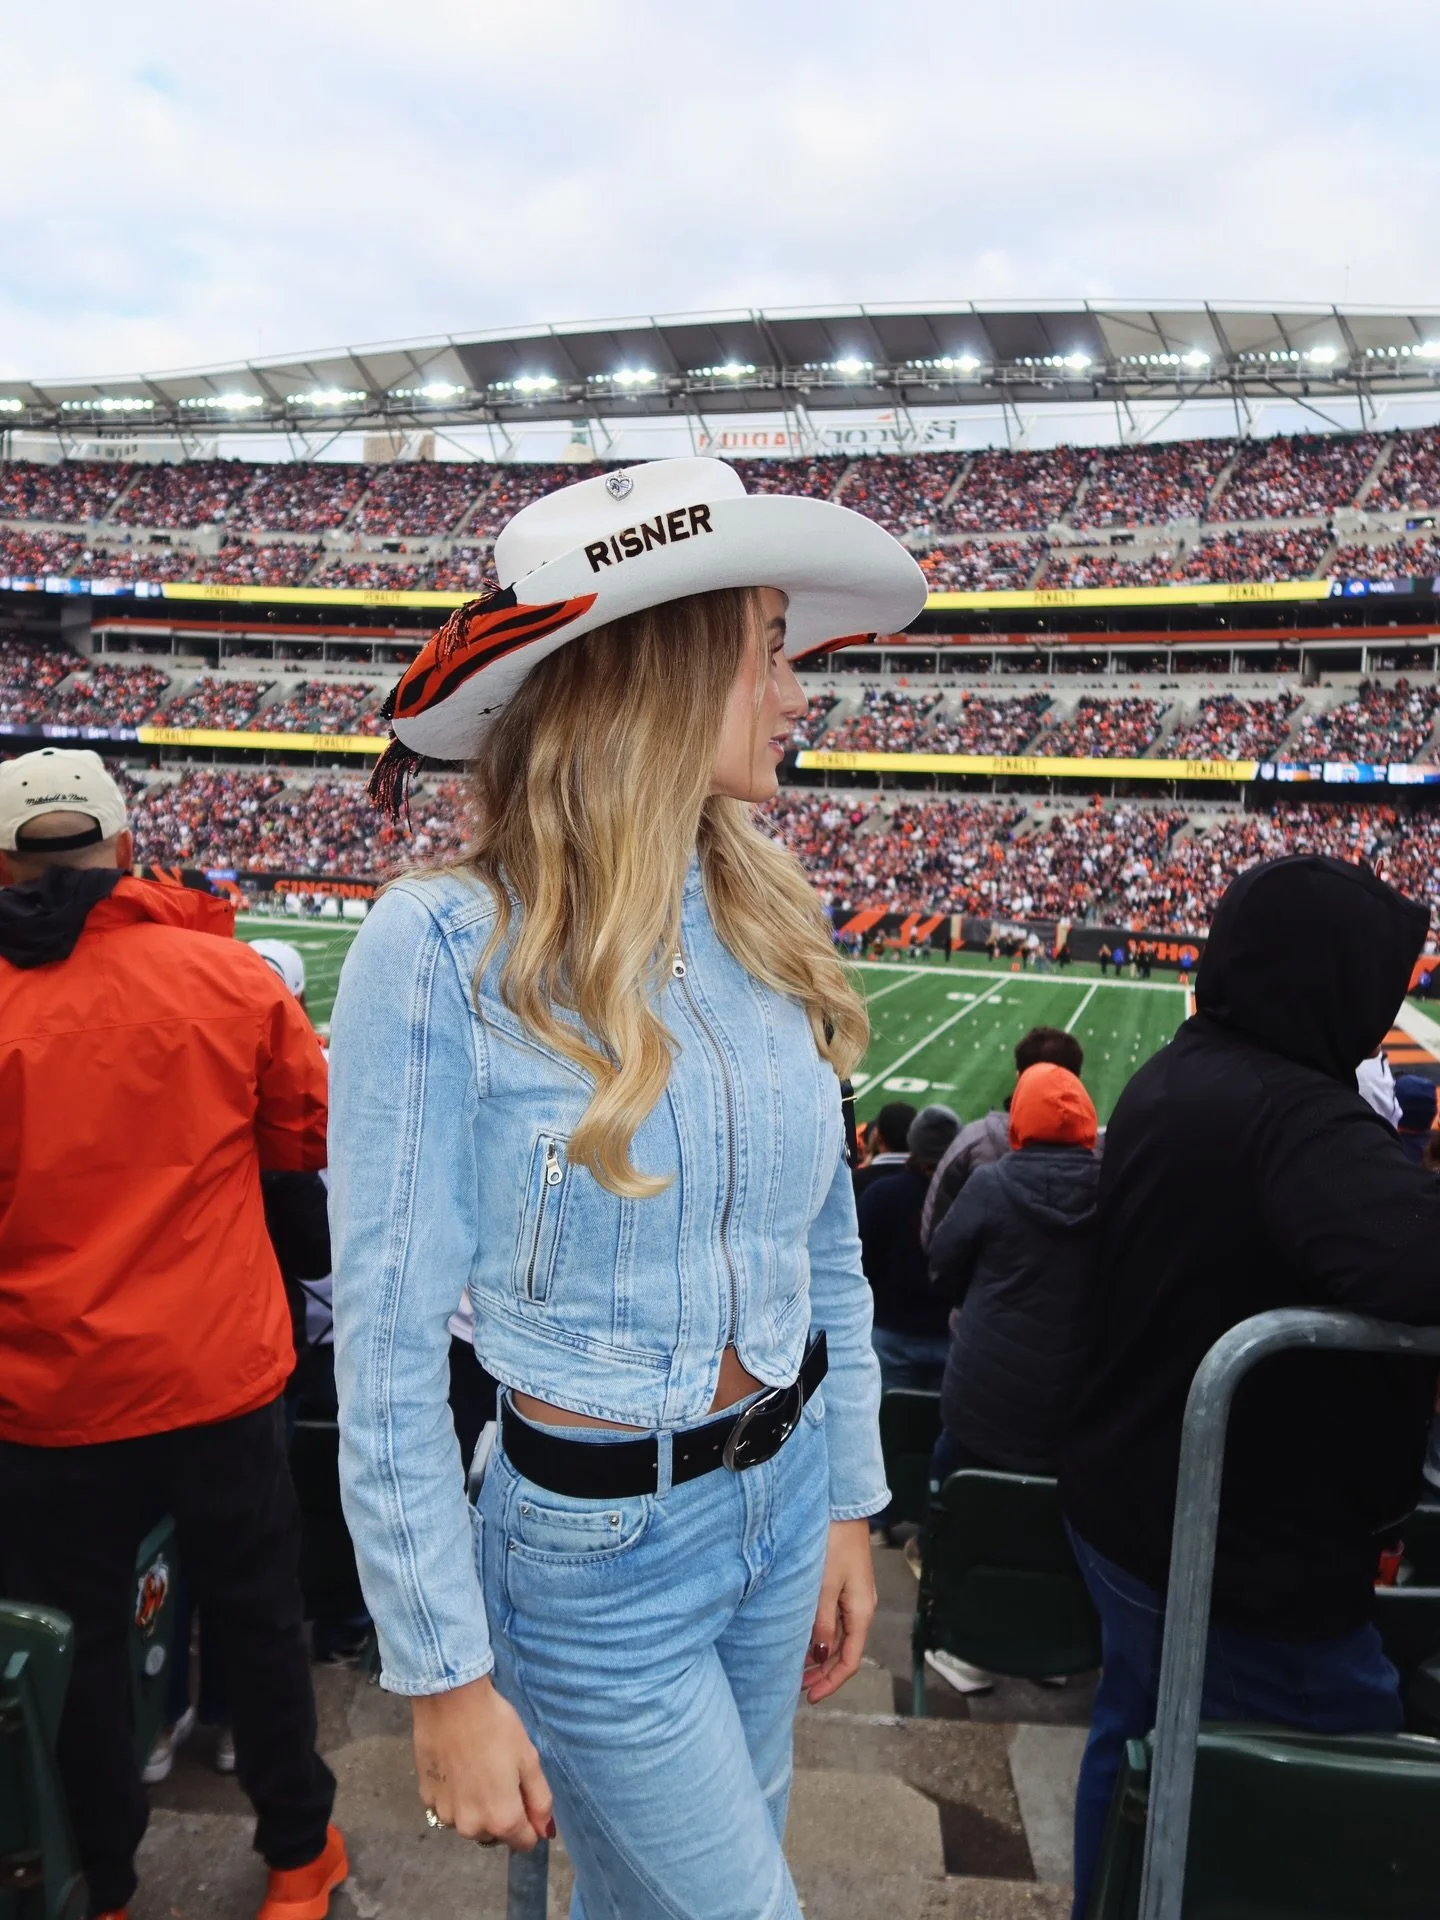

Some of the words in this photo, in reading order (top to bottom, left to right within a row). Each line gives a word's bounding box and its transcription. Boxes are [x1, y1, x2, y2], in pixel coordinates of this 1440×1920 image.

[584, 504, 713, 573] RISNER
[203, 586, 240, 600] PENALTY
[363, 591, 400, 605] PENALTY
[1034, 590, 1076, 606] PENALTY
[1228, 583, 1275, 600] PENALTY
[152, 728, 192, 744] PENALTY
[312, 735, 353, 751] PENALTY
[815, 754, 857, 769] PENALTY
[993, 758, 1038, 774] PENALTY
[1186, 761, 1236, 779] PENALTY
[1128, 939, 1199, 962] WHO
